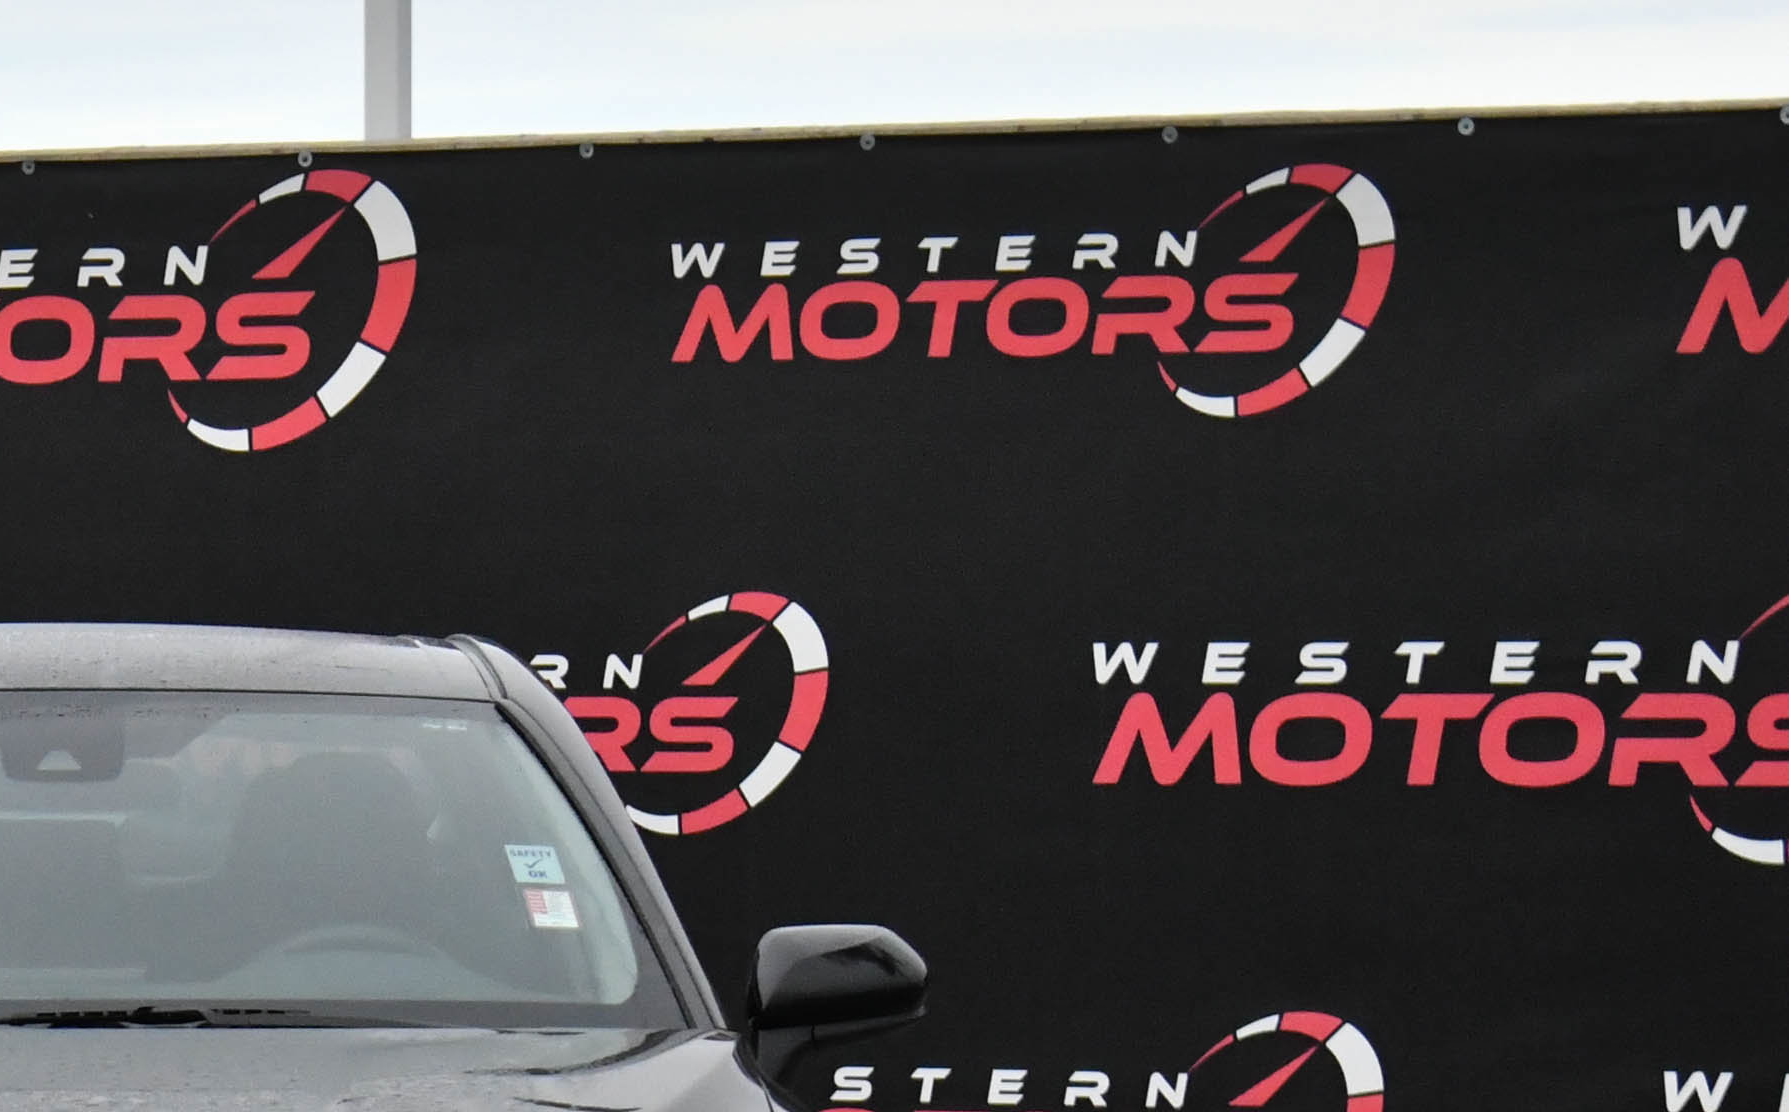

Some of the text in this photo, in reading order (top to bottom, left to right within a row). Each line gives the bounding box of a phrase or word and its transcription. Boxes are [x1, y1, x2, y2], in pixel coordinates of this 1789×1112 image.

[671, 230, 1198, 279] WESTERN
[671, 273, 1298, 363] MOTORS
[1092, 635, 1741, 687] WESTERN
[829, 1066, 1189, 1109] STERN
